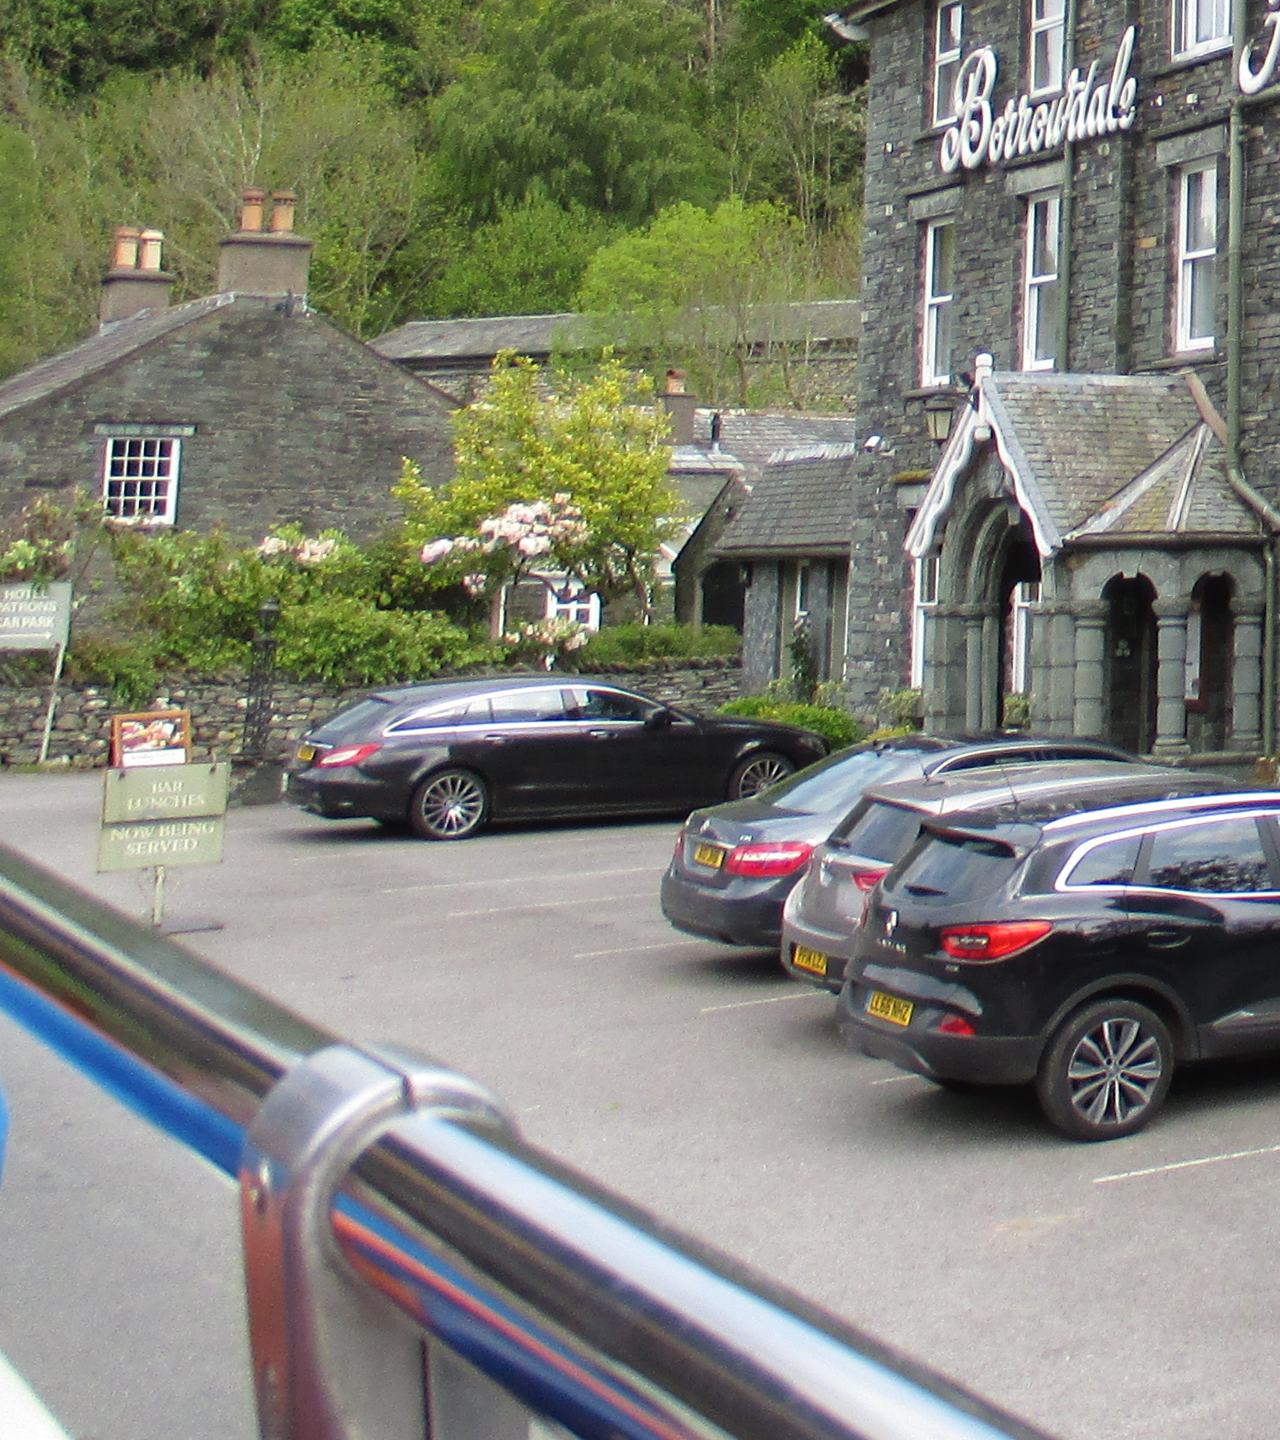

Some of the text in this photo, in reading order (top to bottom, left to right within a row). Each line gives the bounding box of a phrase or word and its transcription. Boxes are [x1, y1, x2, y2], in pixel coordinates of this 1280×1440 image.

[941, 25, 1137, 173] Borrowdale
[4, 589, 48, 599] HOTEL
[21, 616, 56, 628] PARK
[152, 780, 184, 795] BAR
[127, 793, 207, 810] LUNCHES
[110, 820, 215, 841] NOW BEING
[126, 838, 199, 856] SERVED
